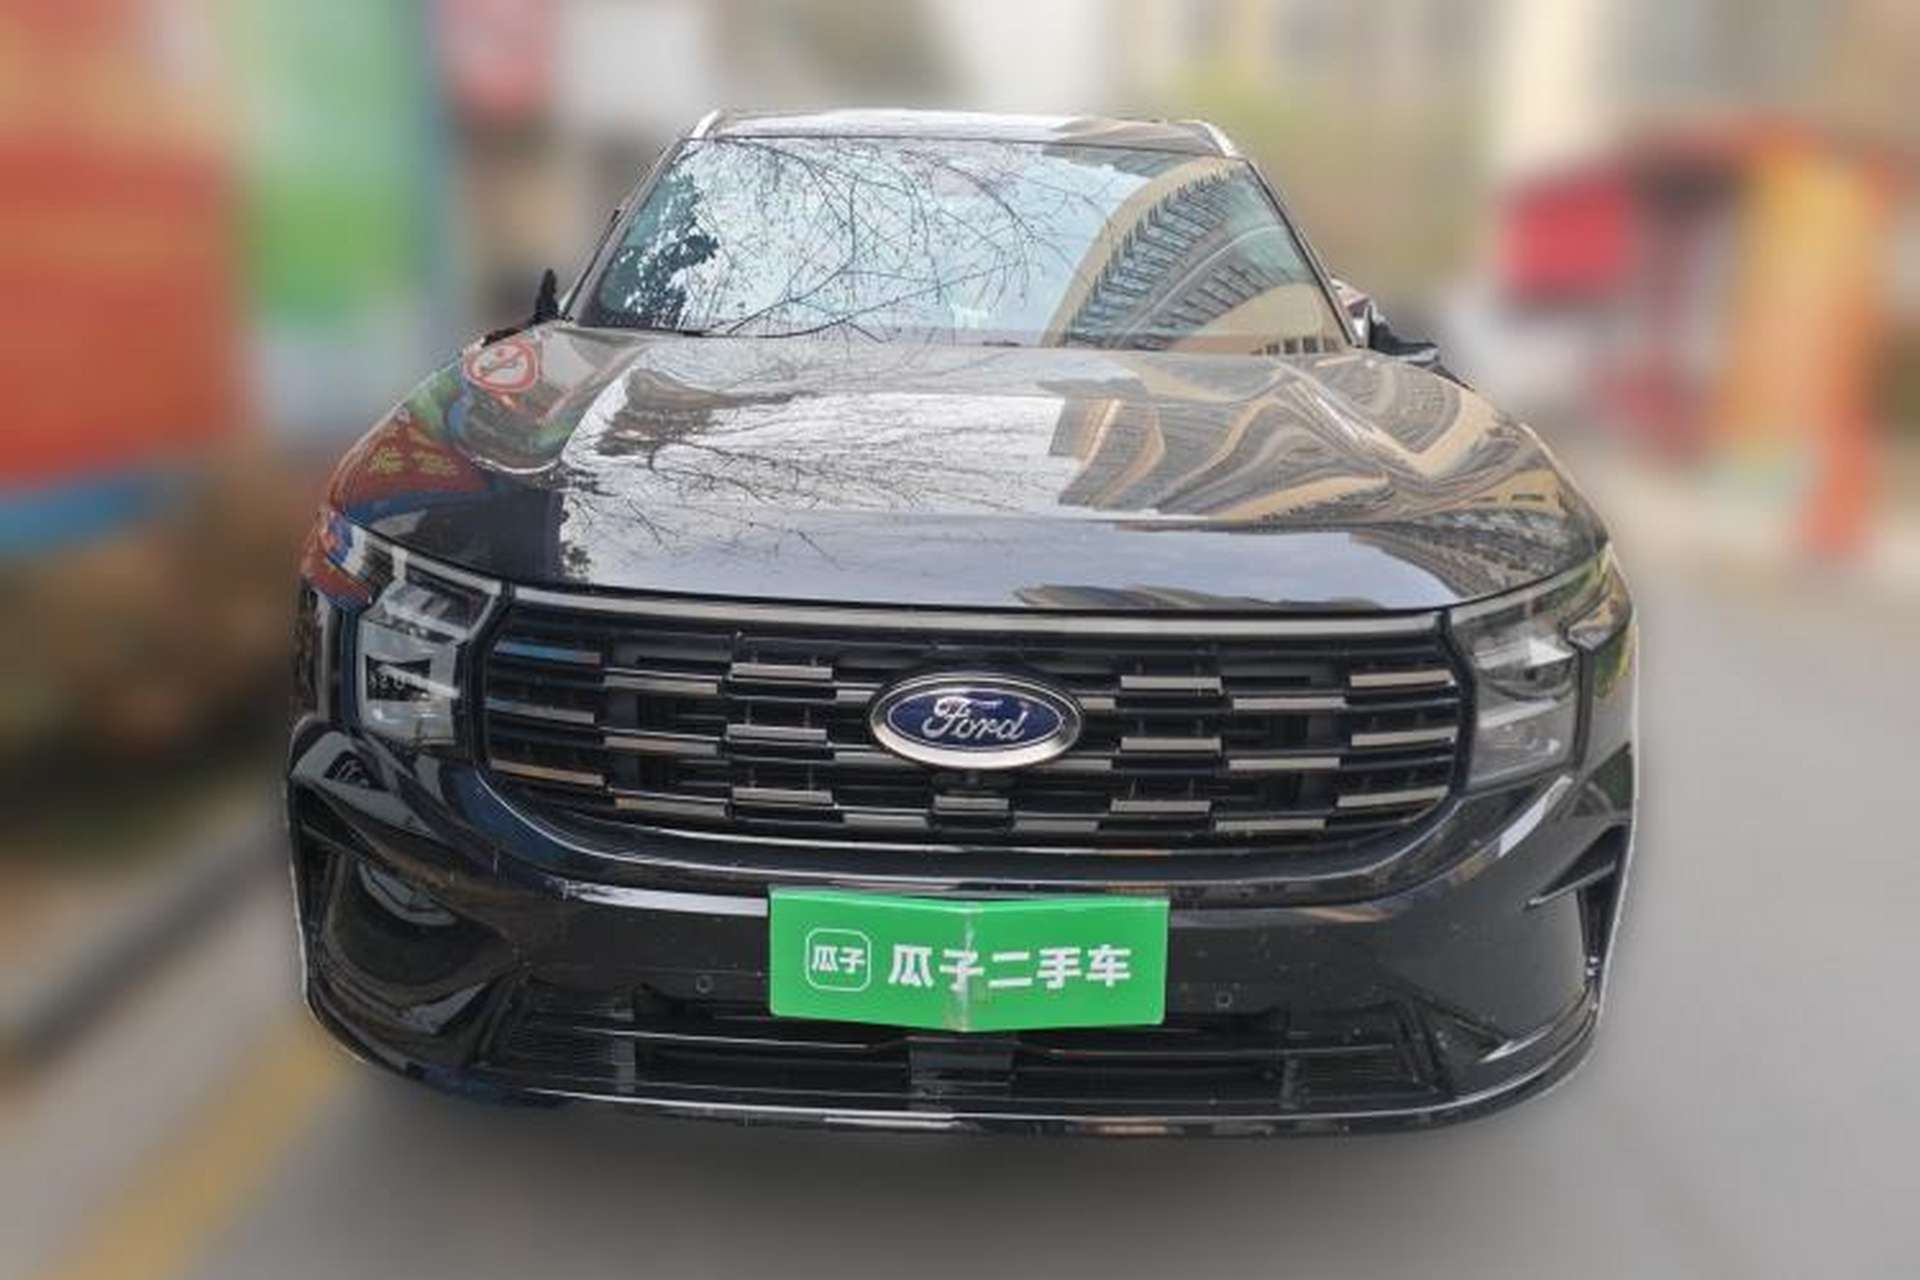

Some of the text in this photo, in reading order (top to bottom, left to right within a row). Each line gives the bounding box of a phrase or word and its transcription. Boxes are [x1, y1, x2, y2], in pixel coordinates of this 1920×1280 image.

[921, 696, 1028, 740] Ford
[811, 945, 866, 974] 瓜子
[888, 944, 1132, 990] 瓜子二手车
